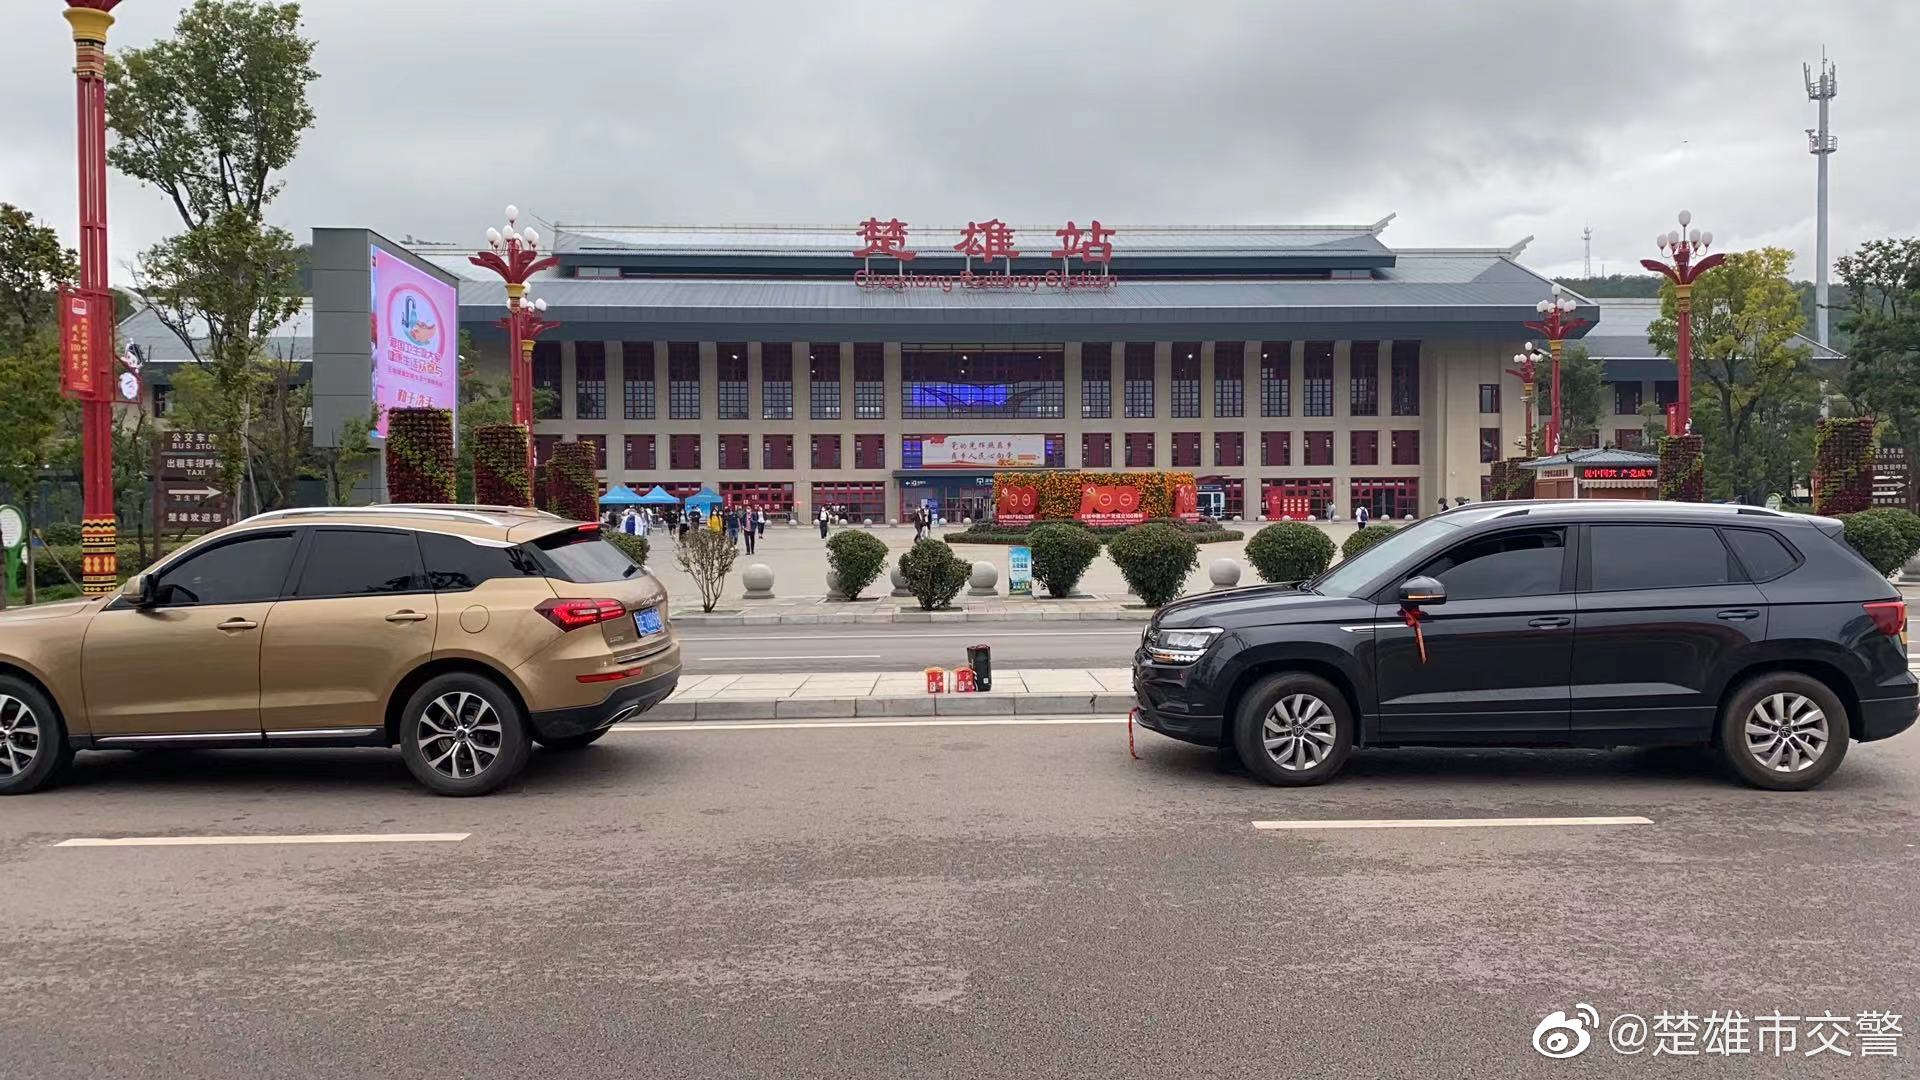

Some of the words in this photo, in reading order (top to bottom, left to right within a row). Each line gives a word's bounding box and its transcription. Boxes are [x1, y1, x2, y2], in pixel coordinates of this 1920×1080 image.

[853, 217, 1116, 264] 楚雄站
[854, 269, 952, 292] Chuxiong
[960, 270, 1040, 292] Railway
[1045, 270, 1117, 288] Station
[175, 494, 200, 502] 卫生间
[168, 512, 222, 523] 楚雄欢迎您
